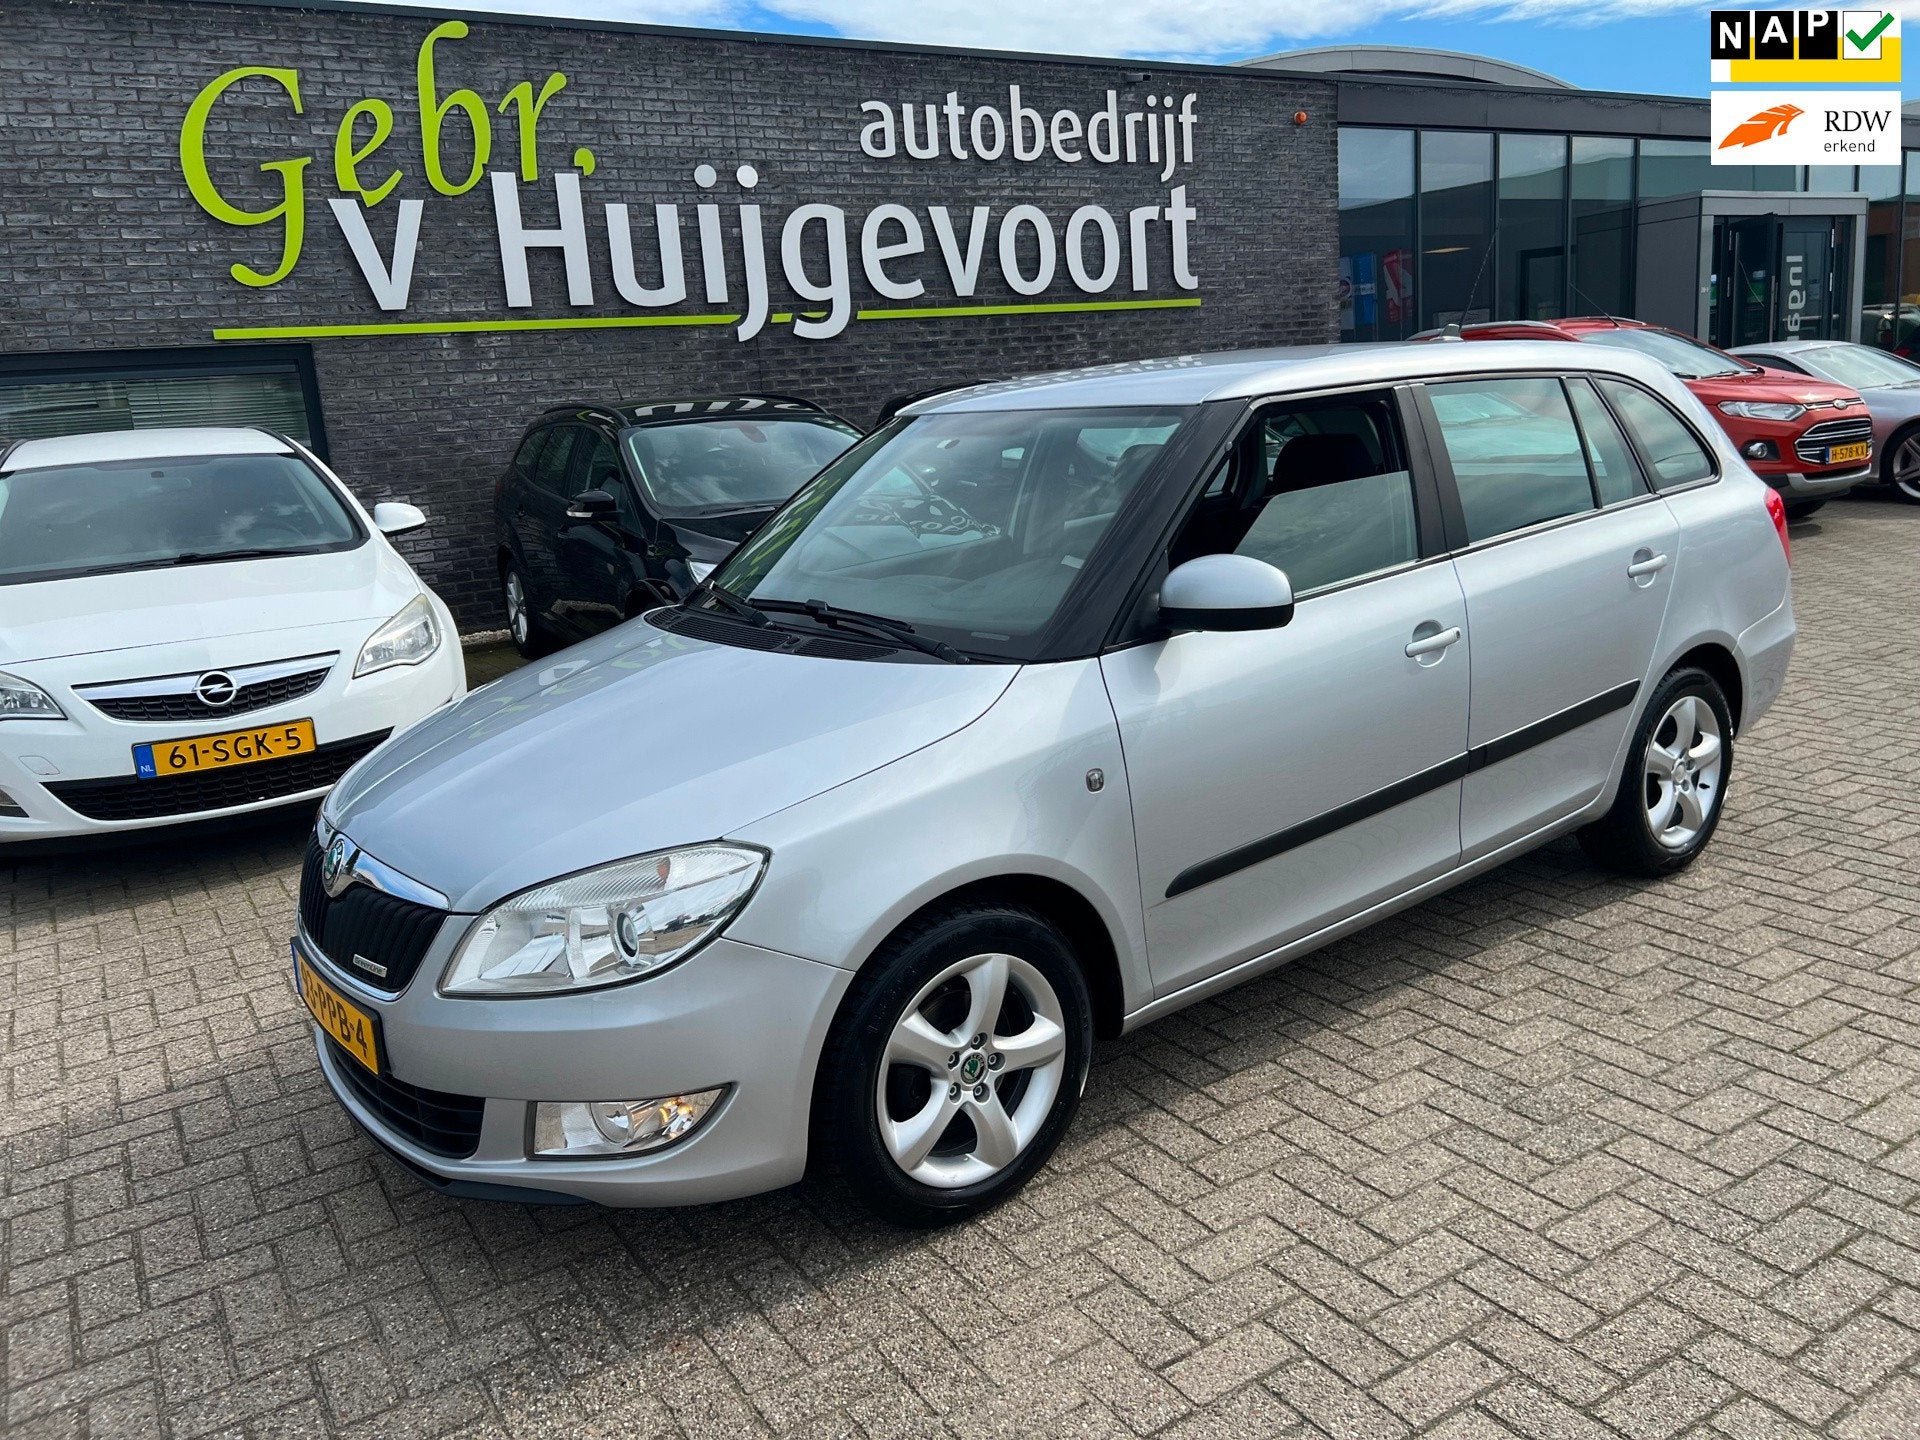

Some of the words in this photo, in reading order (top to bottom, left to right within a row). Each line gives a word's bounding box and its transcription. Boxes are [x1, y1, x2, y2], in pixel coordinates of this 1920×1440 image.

[859, 85, 1198, 182] autobedrijf
[328, 199, 424, 310] v
[490, 172, 1198, 342] Huijgevoort
[140, 764, 154, 773] NL
[169, 728, 302, 768] 61-SGK-5
